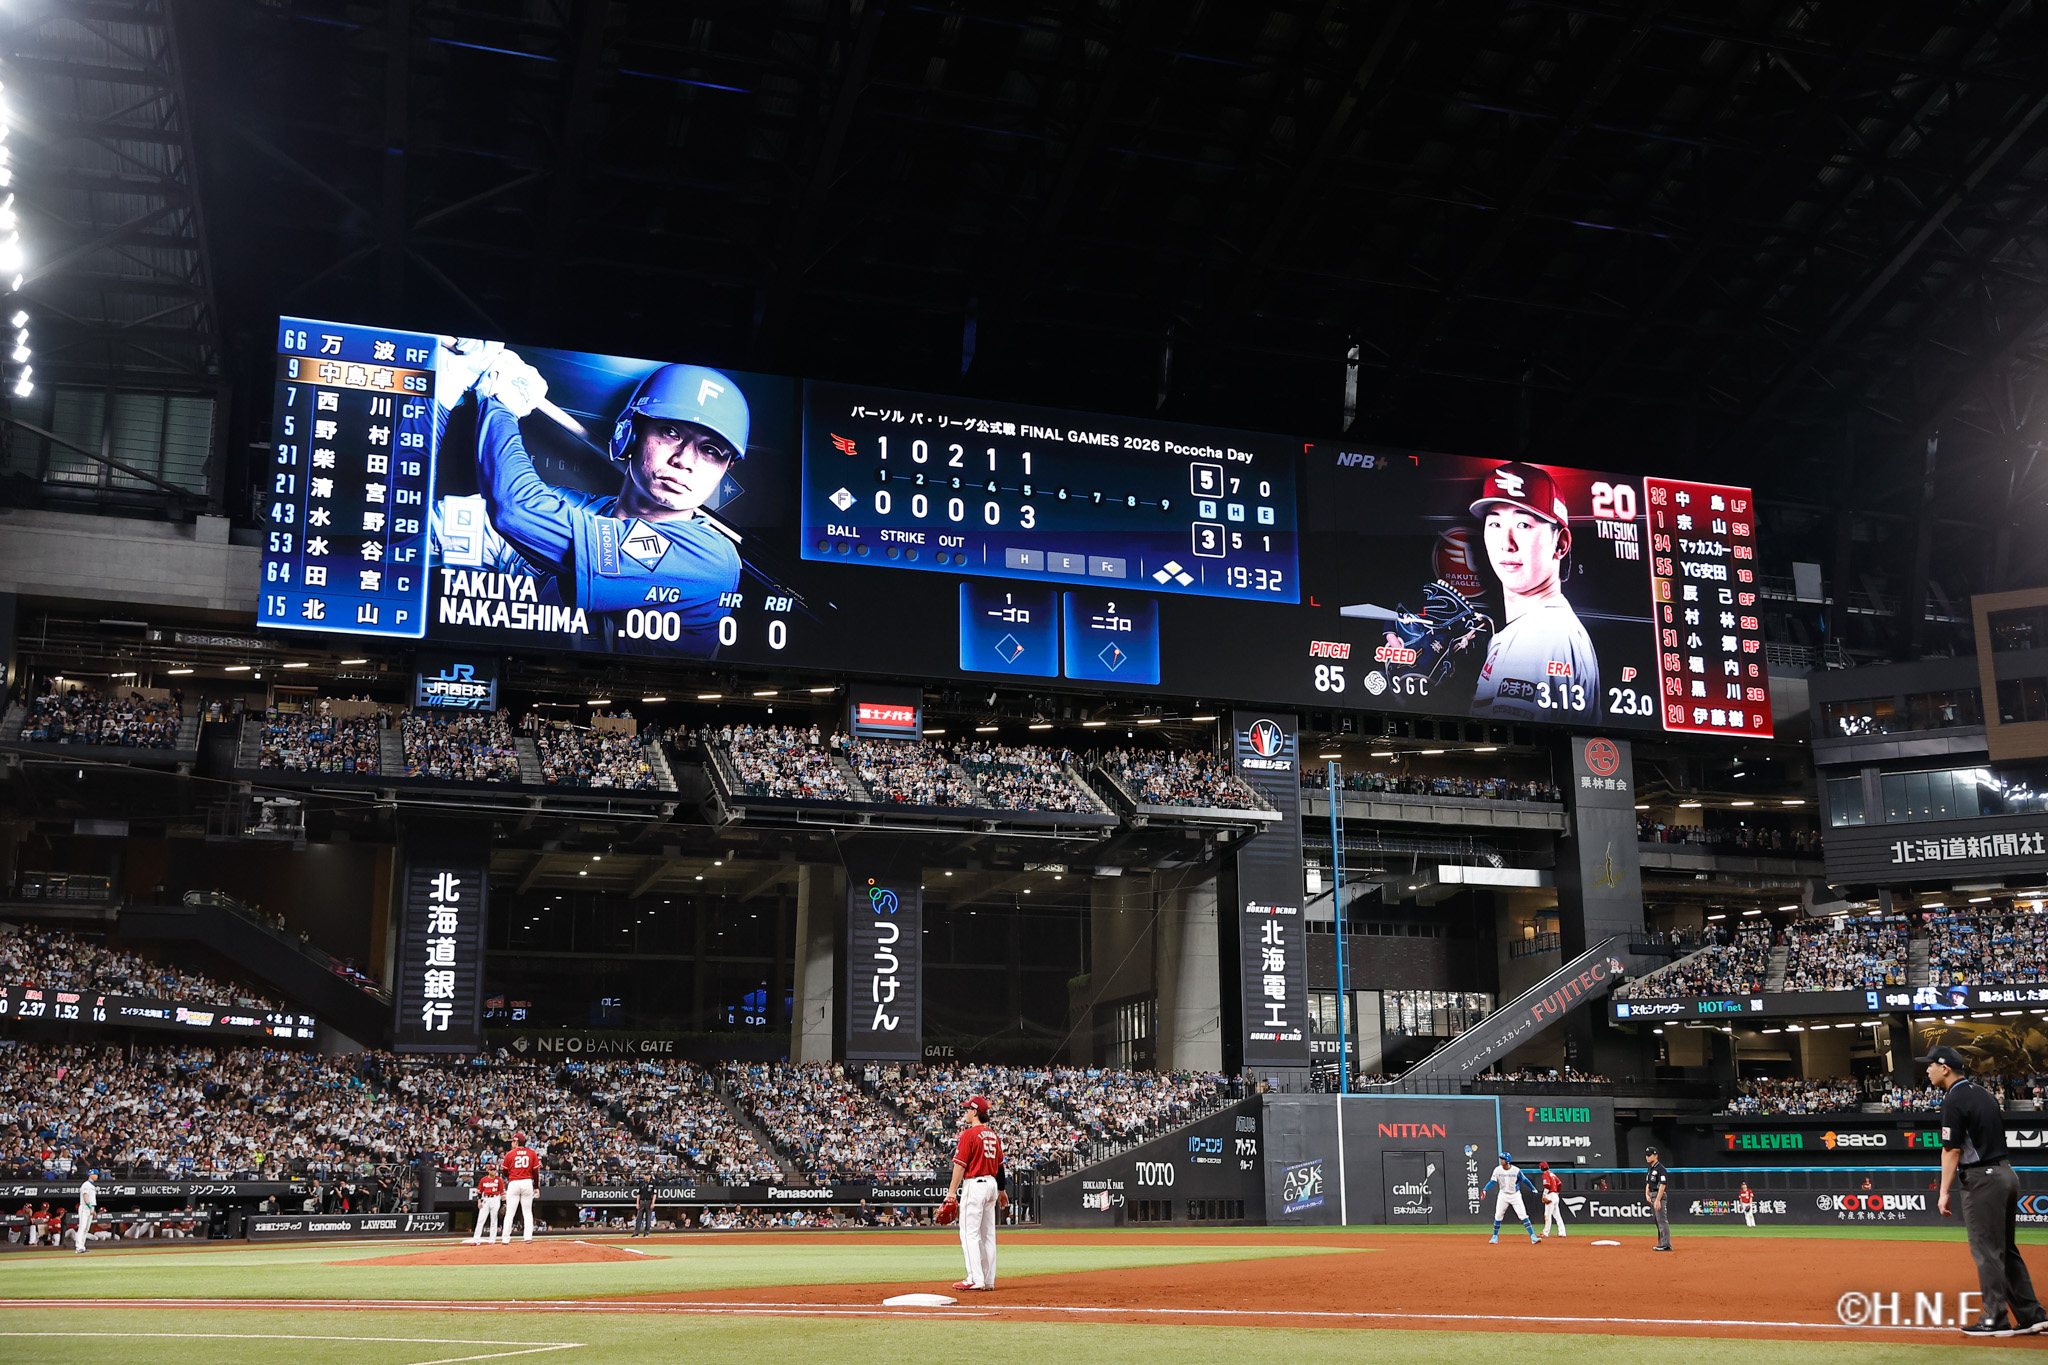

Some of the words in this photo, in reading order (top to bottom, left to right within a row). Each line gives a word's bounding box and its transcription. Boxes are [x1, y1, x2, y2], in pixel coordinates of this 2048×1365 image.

[285, 330, 307, 351] 66
[320, 334, 396, 361] 万波
[406, 348, 429, 363] RF
[288, 359, 299, 378] 9
[319, 362, 395, 388] 中島卓
[403, 376, 427, 391] SS
[317, 391, 392, 417] 西川
[402, 404, 426, 419] CF
[315, 420, 390, 445] 野村
[400, 433, 424, 448] 3B
[851, 406, 904, 424] パーソル
[910, 412, 1016, 436] パ・リーグ公式戦
[1020, 424, 1063, 442] FINAL
[1068, 431, 1119, 448] GAMES
[1123, 437, 1160, 453] 2026
[1164, 441, 1223, 460] Pococha
[1226, 448, 1254, 464] Day
[277, 444, 298, 465] 31
[313, 448, 388, 474] 柴田
[400, 461, 421, 476] 1B
[276, 473, 296, 495] 21
[311, 477, 387, 504] 清宮
[396, 489, 421, 505] DH
[1650, 487, 1667, 506] 32
[1675, 490, 1725, 512] 中島
[1731, 499, 1747, 513] LF
[1591, 481, 1637, 522] 20
[271, 502, 295, 524] 43
[309, 507, 385, 532] 水野
[395, 518, 419, 534] 2B
[1676, 514, 1727, 535] 宗山
[1732, 522, 1749, 536] SS
[827, 524, 861, 539] BALL
[880, 530, 926, 545] STRIKE
[938, 535, 965, 548] OUT
[1595, 520, 1638, 542] TATSUKI
[269, 532, 293, 553] 53
[306, 536, 383, 561] 水谷
[394, 547, 417, 562] LF
[601, 524, 613, 567] NEOBANK
[1614, 540, 1640, 561] ITOH
[1654, 534, 1671, 553] 34
[1679, 538, 1732, 557] マッカスカー
[1734, 546, 1752, 559] DH
[267, 561, 290, 583] 64
[305, 565, 382, 592] 田宮
[1102, 562, 1114, 573] Fc
[1227, 566, 1283, 592] 19:32
[1656, 557, 1673, 576] 55
[1680, 561, 1728, 581] YG安田
[1737, 569, 1753, 583] 1B
[440, 569, 538, 603] TAKUYA
[267, 595, 287, 617] 15
[301, 598, 379, 625] 北山
[645, 586, 680, 603] AVG
[719, 592, 743, 608] HR
[765, 596, 794, 613] RBI
[1738, 592, 1755, 606] CF
[439, 597, 590, 635] NAKASHIMA
[1685, 608, 1735, 629] 村林
[1740, 616, 1758, 630] 2B
[617, 608, 682, 642] .000
[719, 616, 738, 646] 0
[768, 620, 787, 650] 0
[1309, 640, 1351, 660] PITCH
[1374, 646, 1417, 665] SPEED
[1663, 629, 1678, 648] 51
[1742, 639, 1760, 654] RF
[440, 663, 475, 683] JR
[1546, 660, 1573, 678] ERA
[1622, 667, 1638, 683] IP
[1663, 653, 1681, 672] 65
[427, 682, 486, 697] JR西日本
[1314, 664, 1346, 693] 85
[1666, 677, 1683, 696] 24
[1746, 687, 1765, 702] 3B
[1536, 682, 1587, 711] 3.13
[1608, 687, 1654, 716] 23.0
[859, 708, 913, 722] 富士メガネ
[1668, 704, 1685, 724] 20
[1242, 759, 1292, 771] 北海道シミズ
[1581, 776, 1627, 792] 栗林商会
[1890, 831, 2046, 863] 北海道新聞社
[1246, 905, 1272, 914] HOKKAI
[422, 872, 460, 1031] 北海道銀行
[872, 921, 900, 1031] つうけん
[1261, 920, 1287, 1026] 北海電工
[25, 989, 43, 1001] ERA
[57, 992, 80, 1004] WHIP
[96, 996, 105, 1006] K
[1530, 963, 1607, 1023] FUJITEC
[1865, 991, 1880, 1010] 9
[18, 1001, 46, 1017] 2.37
[54, 1003, 80, 1019] 1.52
[92, 1007, 107, 1022] 16
[1698, 1000, 1725, 1014] HOT
[1727, 1003, 1742, 1013] net
[537, 1037, 582, 1053] NEO
[586, 1037, 636, 1054] BANK
[641, 1040, 674, 1053] GATE
[1250, 1032, 1276, 1041] HOKKAI
[1461, 1018, 1532, 1071] エレベータ・エスカレータ
[925, 1045, 955, 1057] GATE
[1378, 1123, 1447, 1138] NITTAN
[1527, 1135, 1561, 1147] ユンケル
[1562, 1136, 1592, 1147] ローヤル
[1836, 1134, 1886, 1147] sato
[983, 1139, 998, 1159] 55
[1189, 1136, 1223, 1154] パワーエンジ
[1235, 1138, 1257, 1156] アトラス
[514, 1155, 530, 1168] 20
[1083, 1180, 1106, 1190] HOKKAIDO
[1135, 1161, 1175, 1187] TOTO
[1283, 1164, 1323, 1189] ASK
[141, 1186, 181, 1194] SMBCモビット
[189, 1184, 236, 1195] ジンワークス
[581, 1188, 629, 1200] Panasonic
[657, 1189, 696, 1199] LOUNGE
[767, 1186, 834, 1200] Panasonic
[872, 1188, 920, 1199] Panasonic
[924, 1187, 950, 1198] CLUB
[1283, 1181, 1324, 1202] GATE
[1466, 1159, 1480, 1215] 北洋銀行
[1393, 1206, 1433, 1215] 日本カルミック
[1590, 1201, 1653, 1217] Fanatic
[1833, 1195, 1926, 1211] KOTOBUKI
[308, 1221, 351, 1232] kanamoto
[360, 1219, 397, 1230] LAWSON
[413, 1221, 445, 1231] アイエンジ
[1837, 1211, 1906, 1221] 寿産業株式会社
